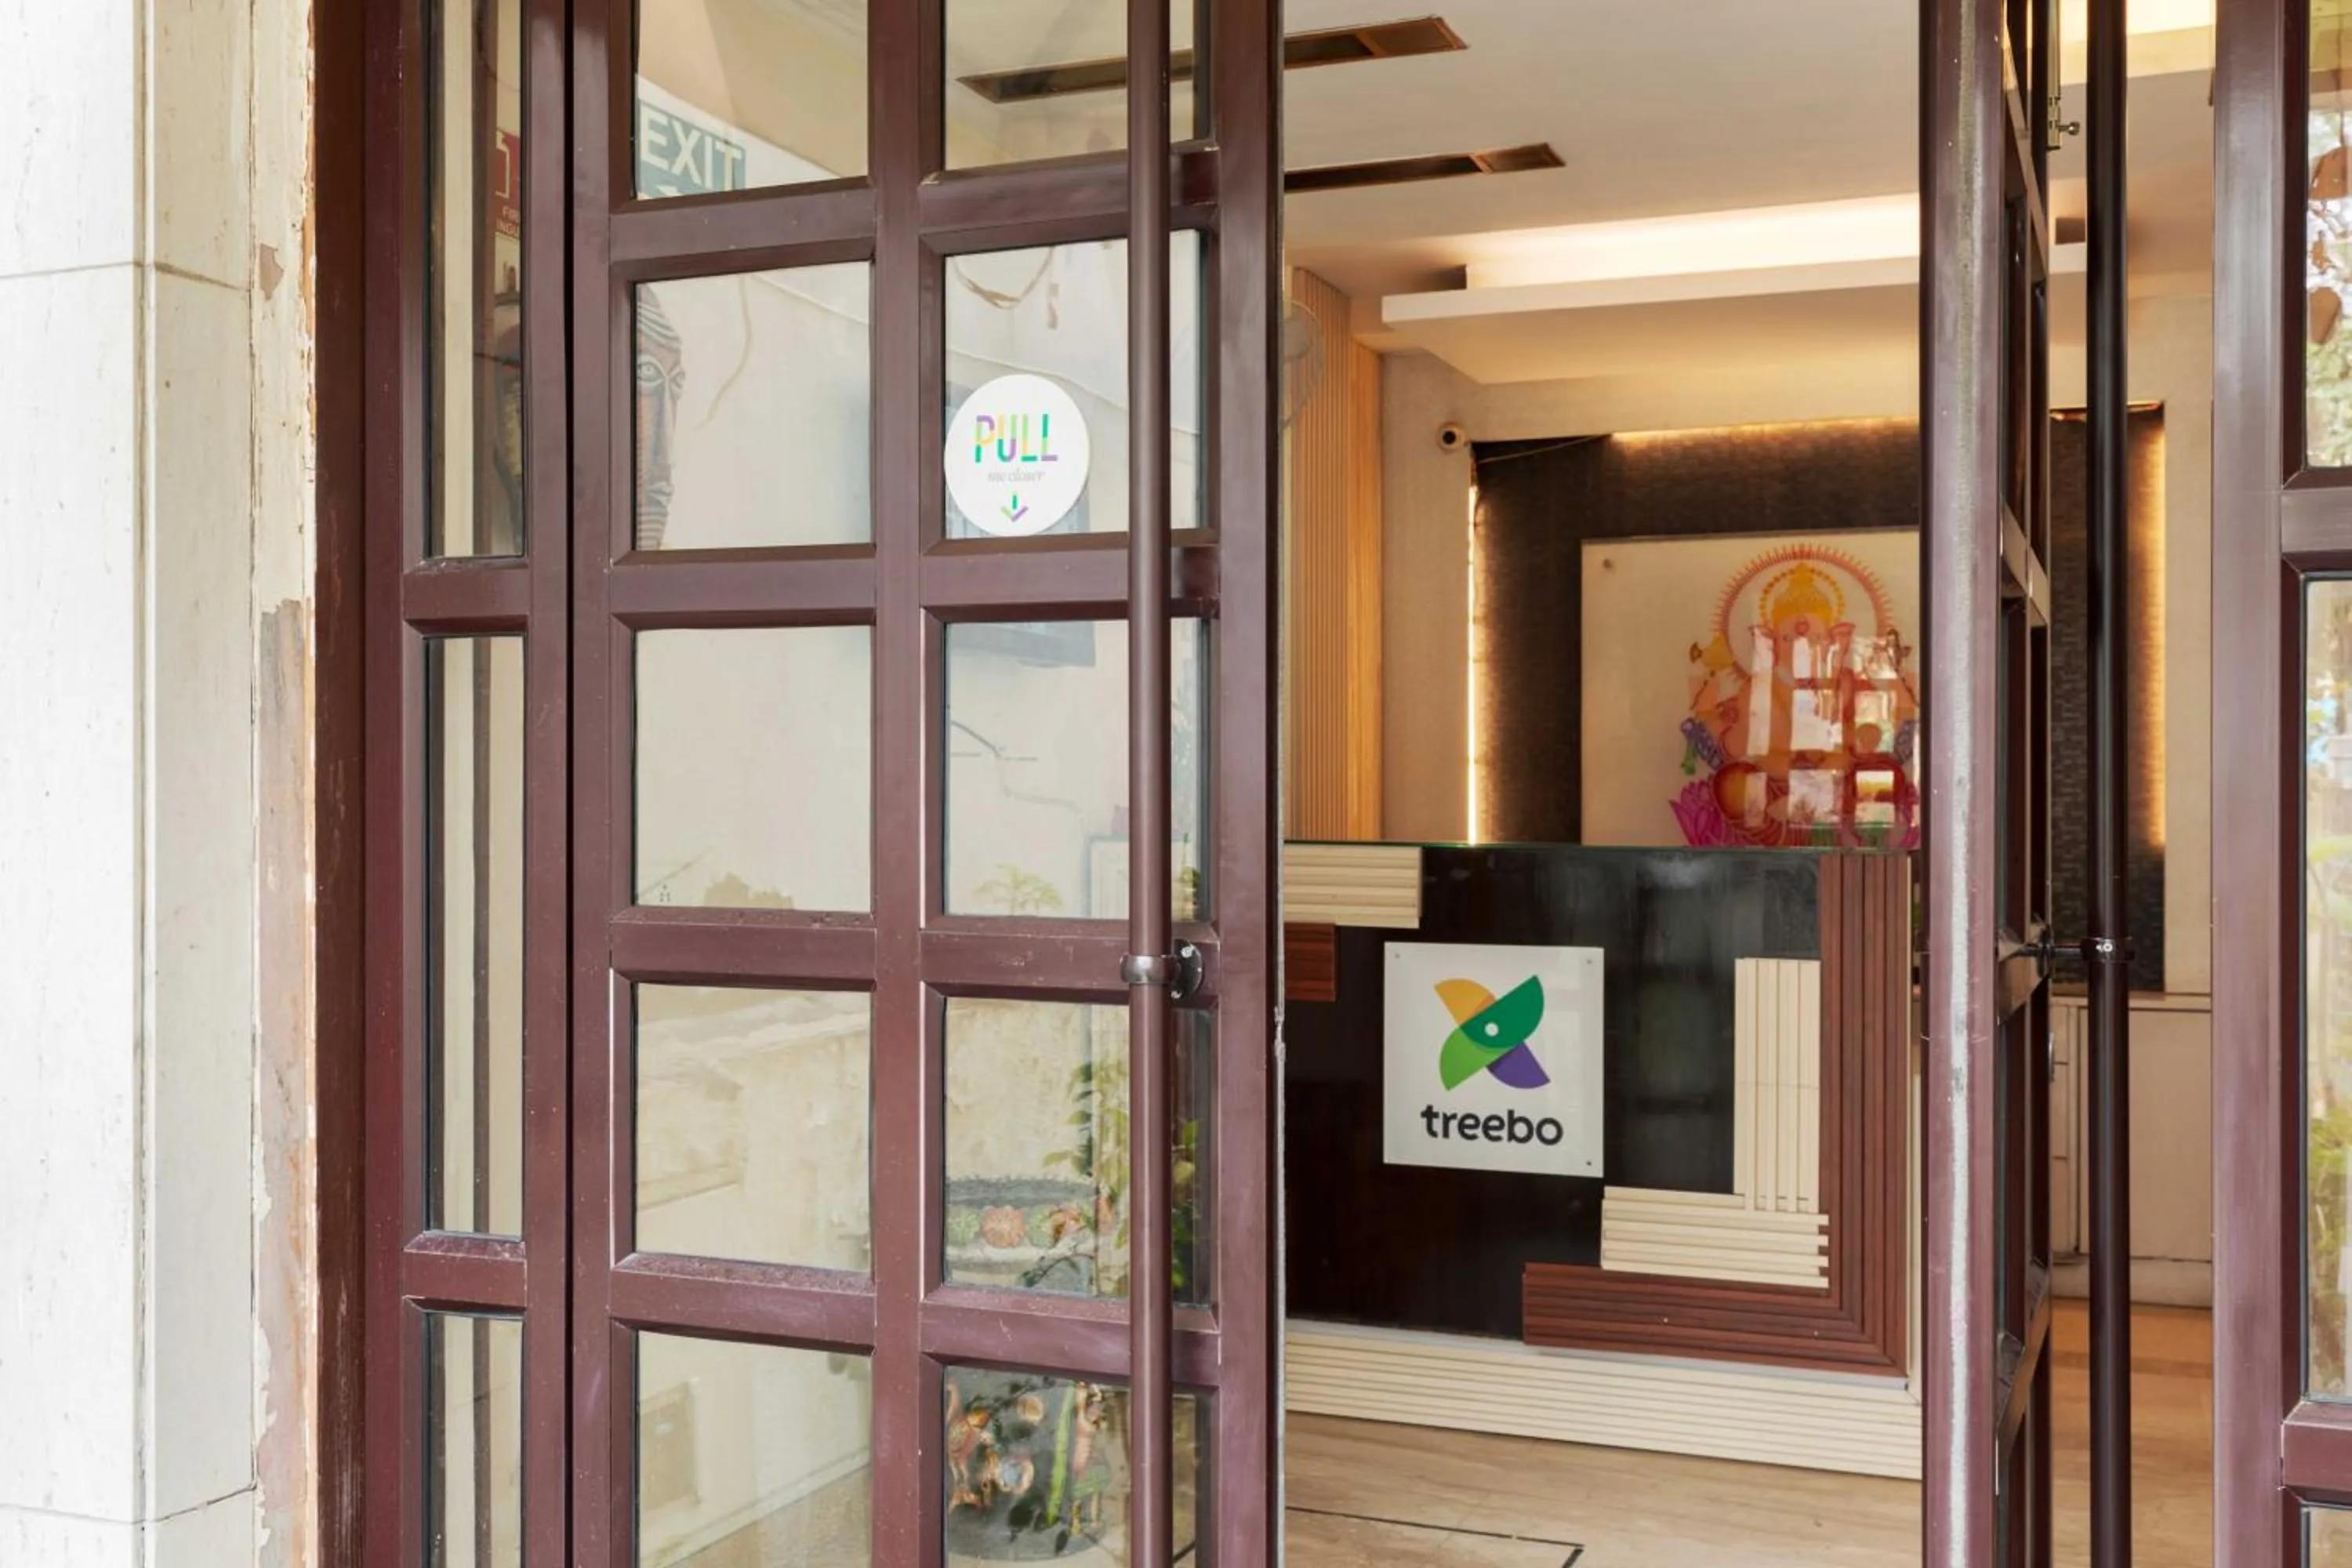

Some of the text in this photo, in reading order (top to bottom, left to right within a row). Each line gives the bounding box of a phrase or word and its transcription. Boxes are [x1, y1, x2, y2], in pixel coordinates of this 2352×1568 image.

[639, 103, 742, 191] EXIT
[975, 412, 1058, 463] PULL
[1420, 1104, 1564, 1145] treebo
